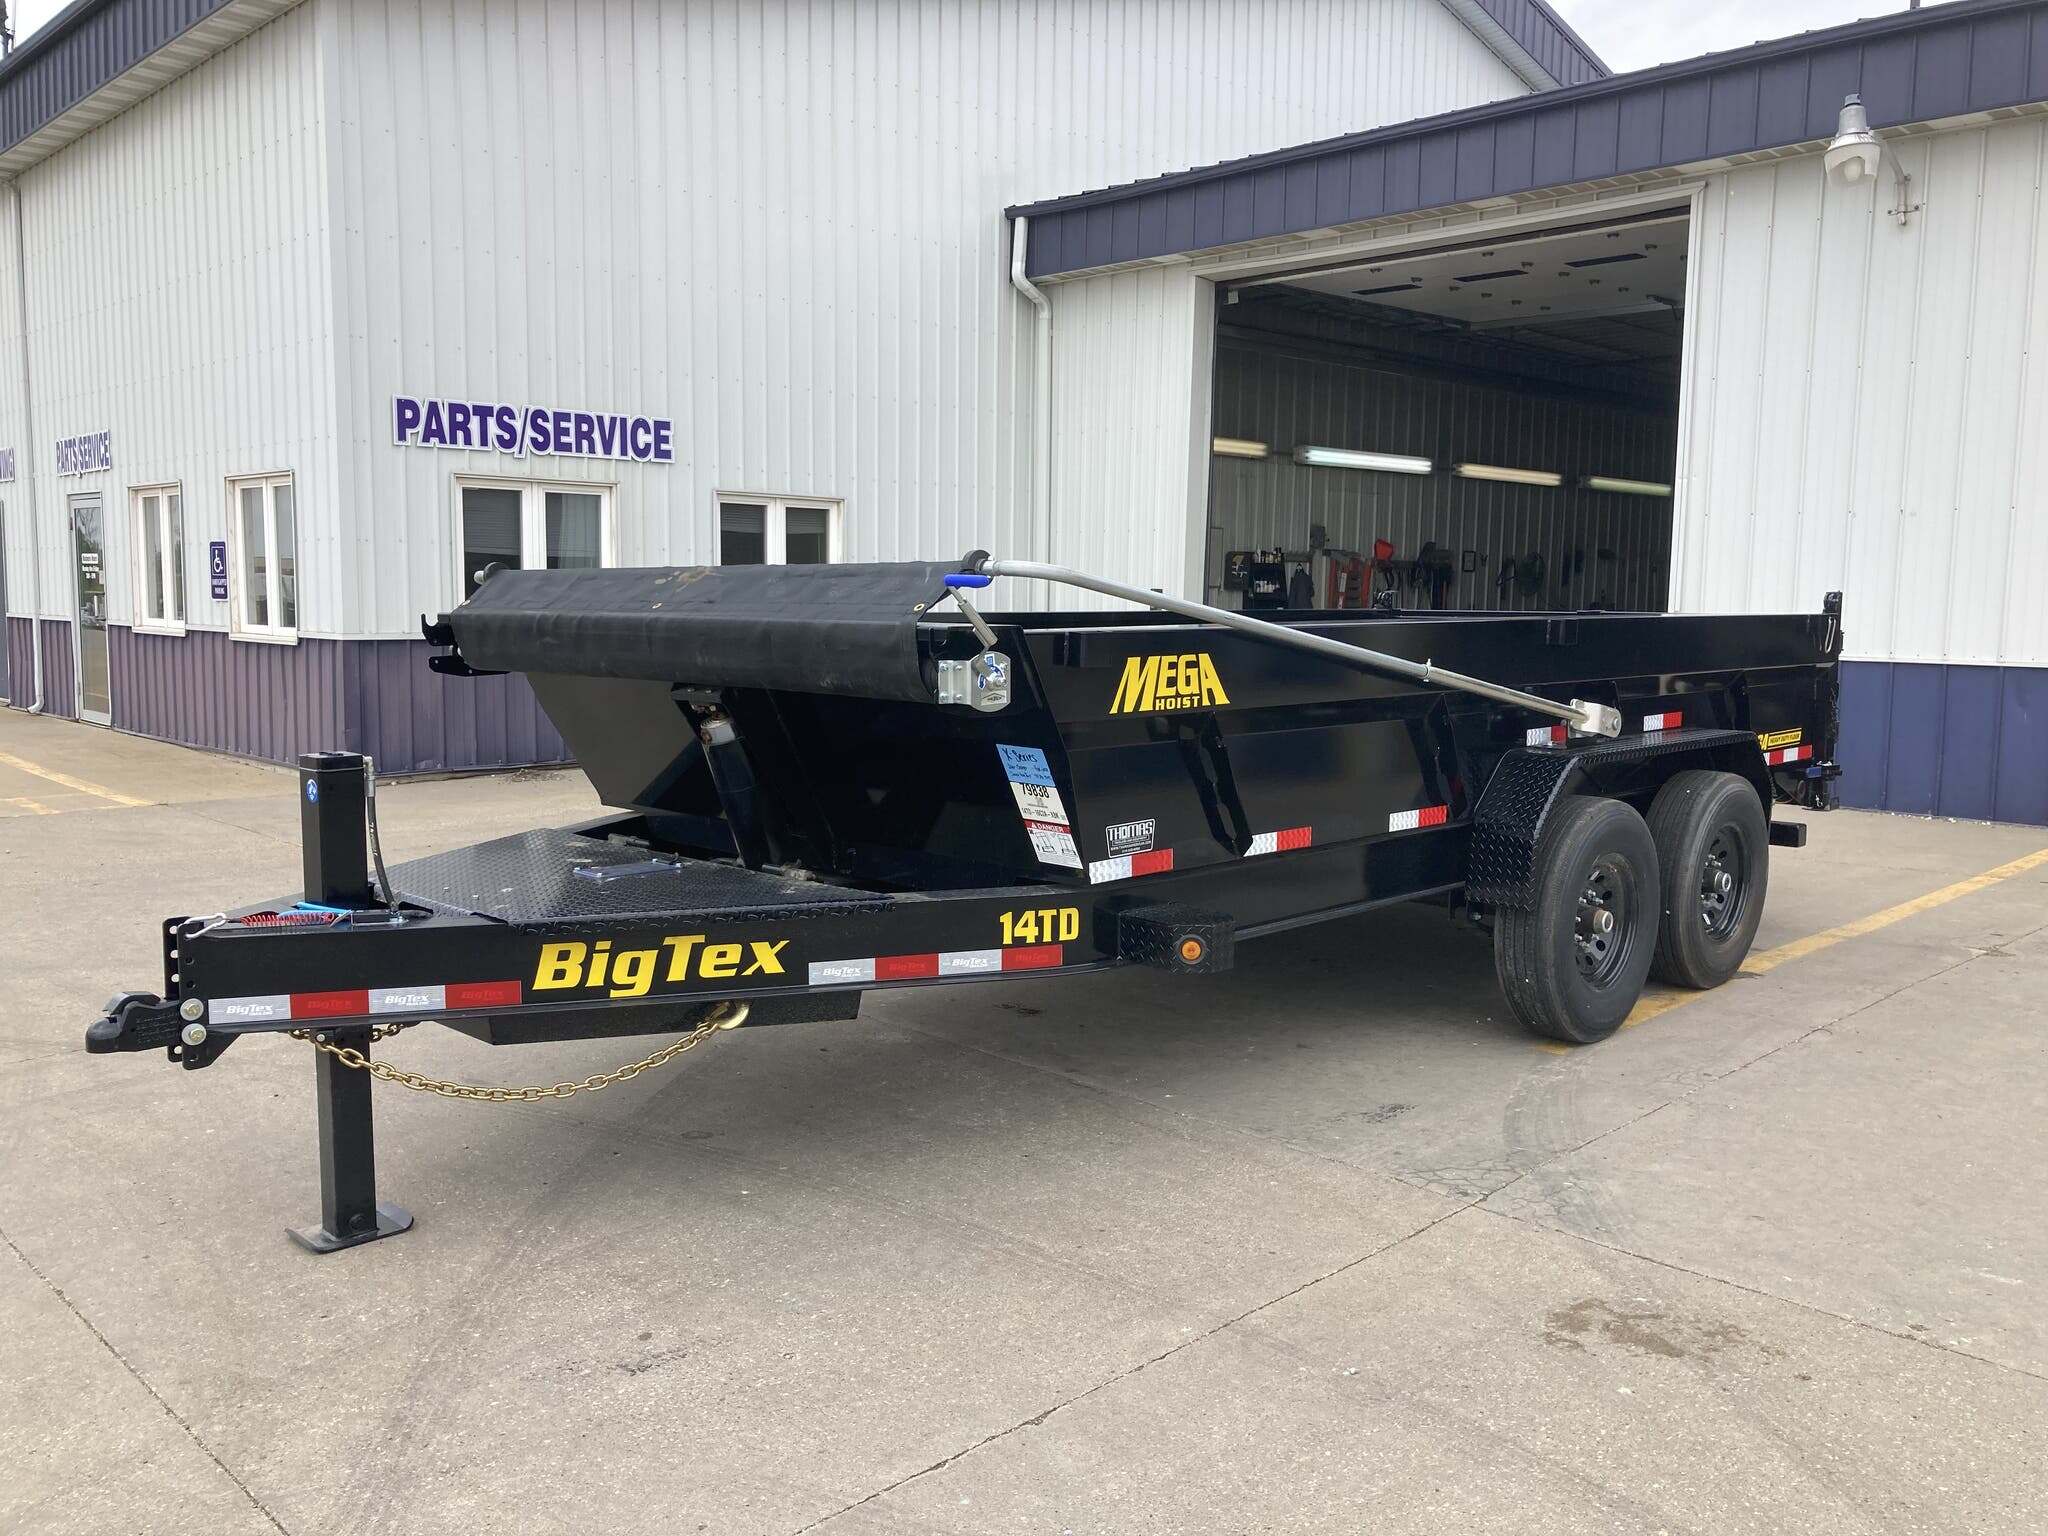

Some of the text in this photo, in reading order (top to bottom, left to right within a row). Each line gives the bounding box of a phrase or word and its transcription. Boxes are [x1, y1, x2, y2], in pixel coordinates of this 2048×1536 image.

[396, 398, 673, 460] PARTS/SERVICE
[56, 431, 110, 476] PARTS/SERVICE
[1109, 653, 1230, 714] MEGA
[1155, 696, 1200, 710] HOIST
[1108, 822, 1152, 841] THOMAS
[999, 907, 1079, 944] 14TD
[532, 935, 790, 998] BigTex
[226, 1004, 273, 1015] BigTex
[384, 994, 429, 1005] BigTex
